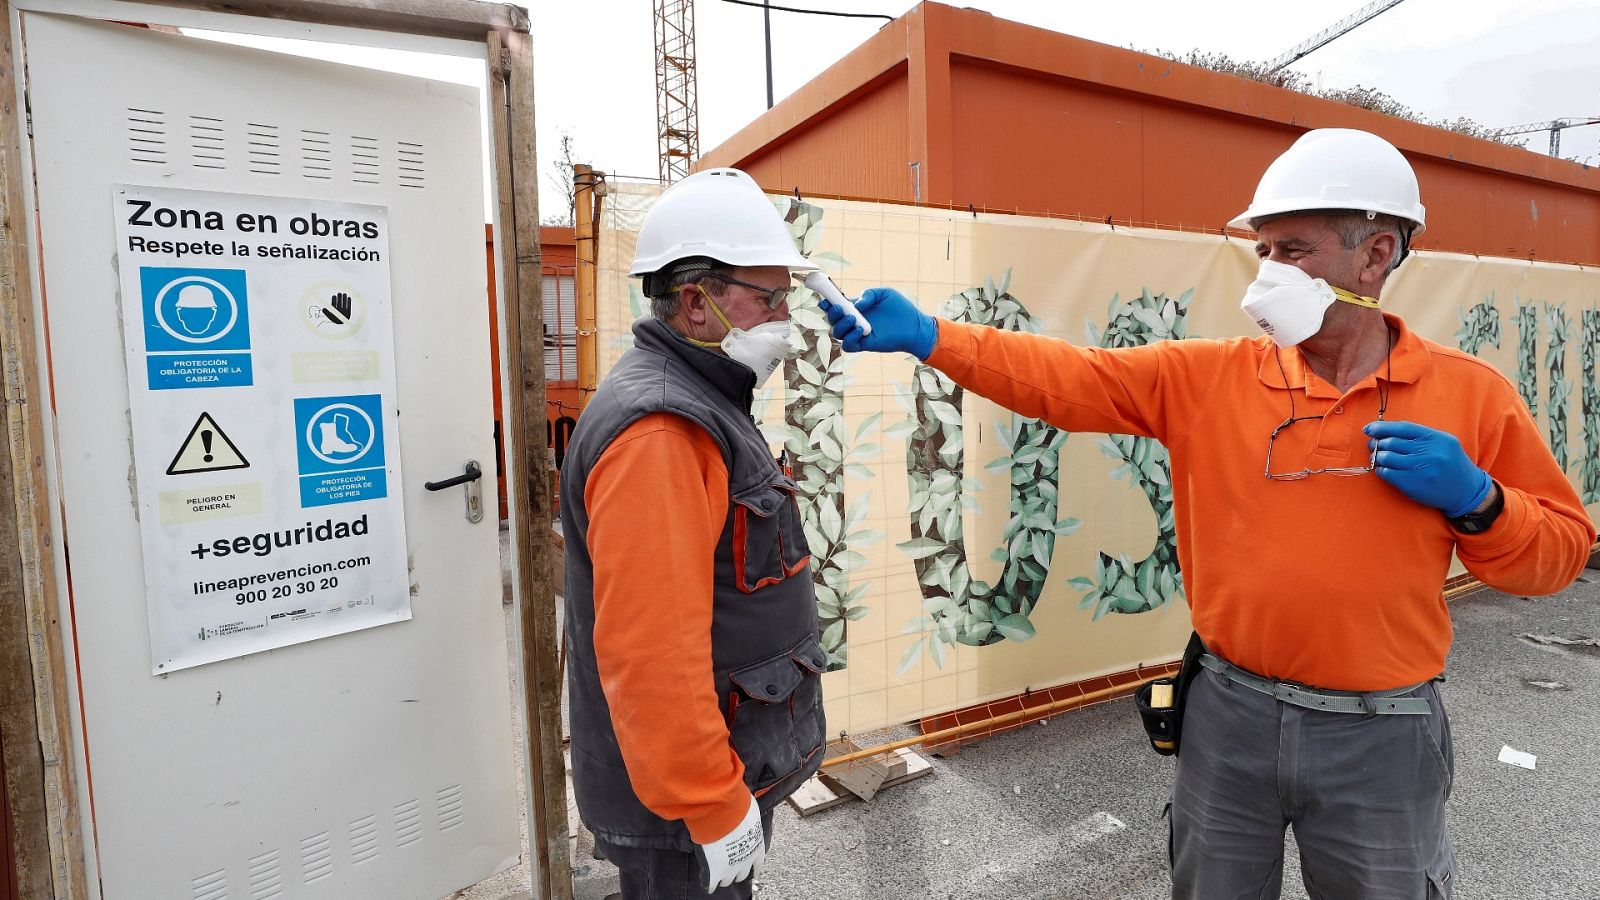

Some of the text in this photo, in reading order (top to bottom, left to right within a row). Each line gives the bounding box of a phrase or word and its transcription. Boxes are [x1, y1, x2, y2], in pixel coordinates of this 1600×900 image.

[127, 200, 379, 239] Zona en obras
[128, 236, 380, 262] Respete la señalización
[173, 358, 228, 367] PROTECCIÓN
[160, 366, 242, 376] OBLIGATORIA DE LA
[185, 375, 219, 383] CABEZA
[321, 475, 366, 485] PROTECCIÓN
[315, 484, 362, 493] OBLIGATORIA
[345, 490, 361, 498] PIES
[186, 494, 236, 505] PELIGRO EN
[192, 502, 232, 513] GENERAL
[190, 514, 368, 559] +seguridad
[193, 556, 371, 595] lineaprevencion.com
[235, 576, 339, 606] 900 20 30 20
